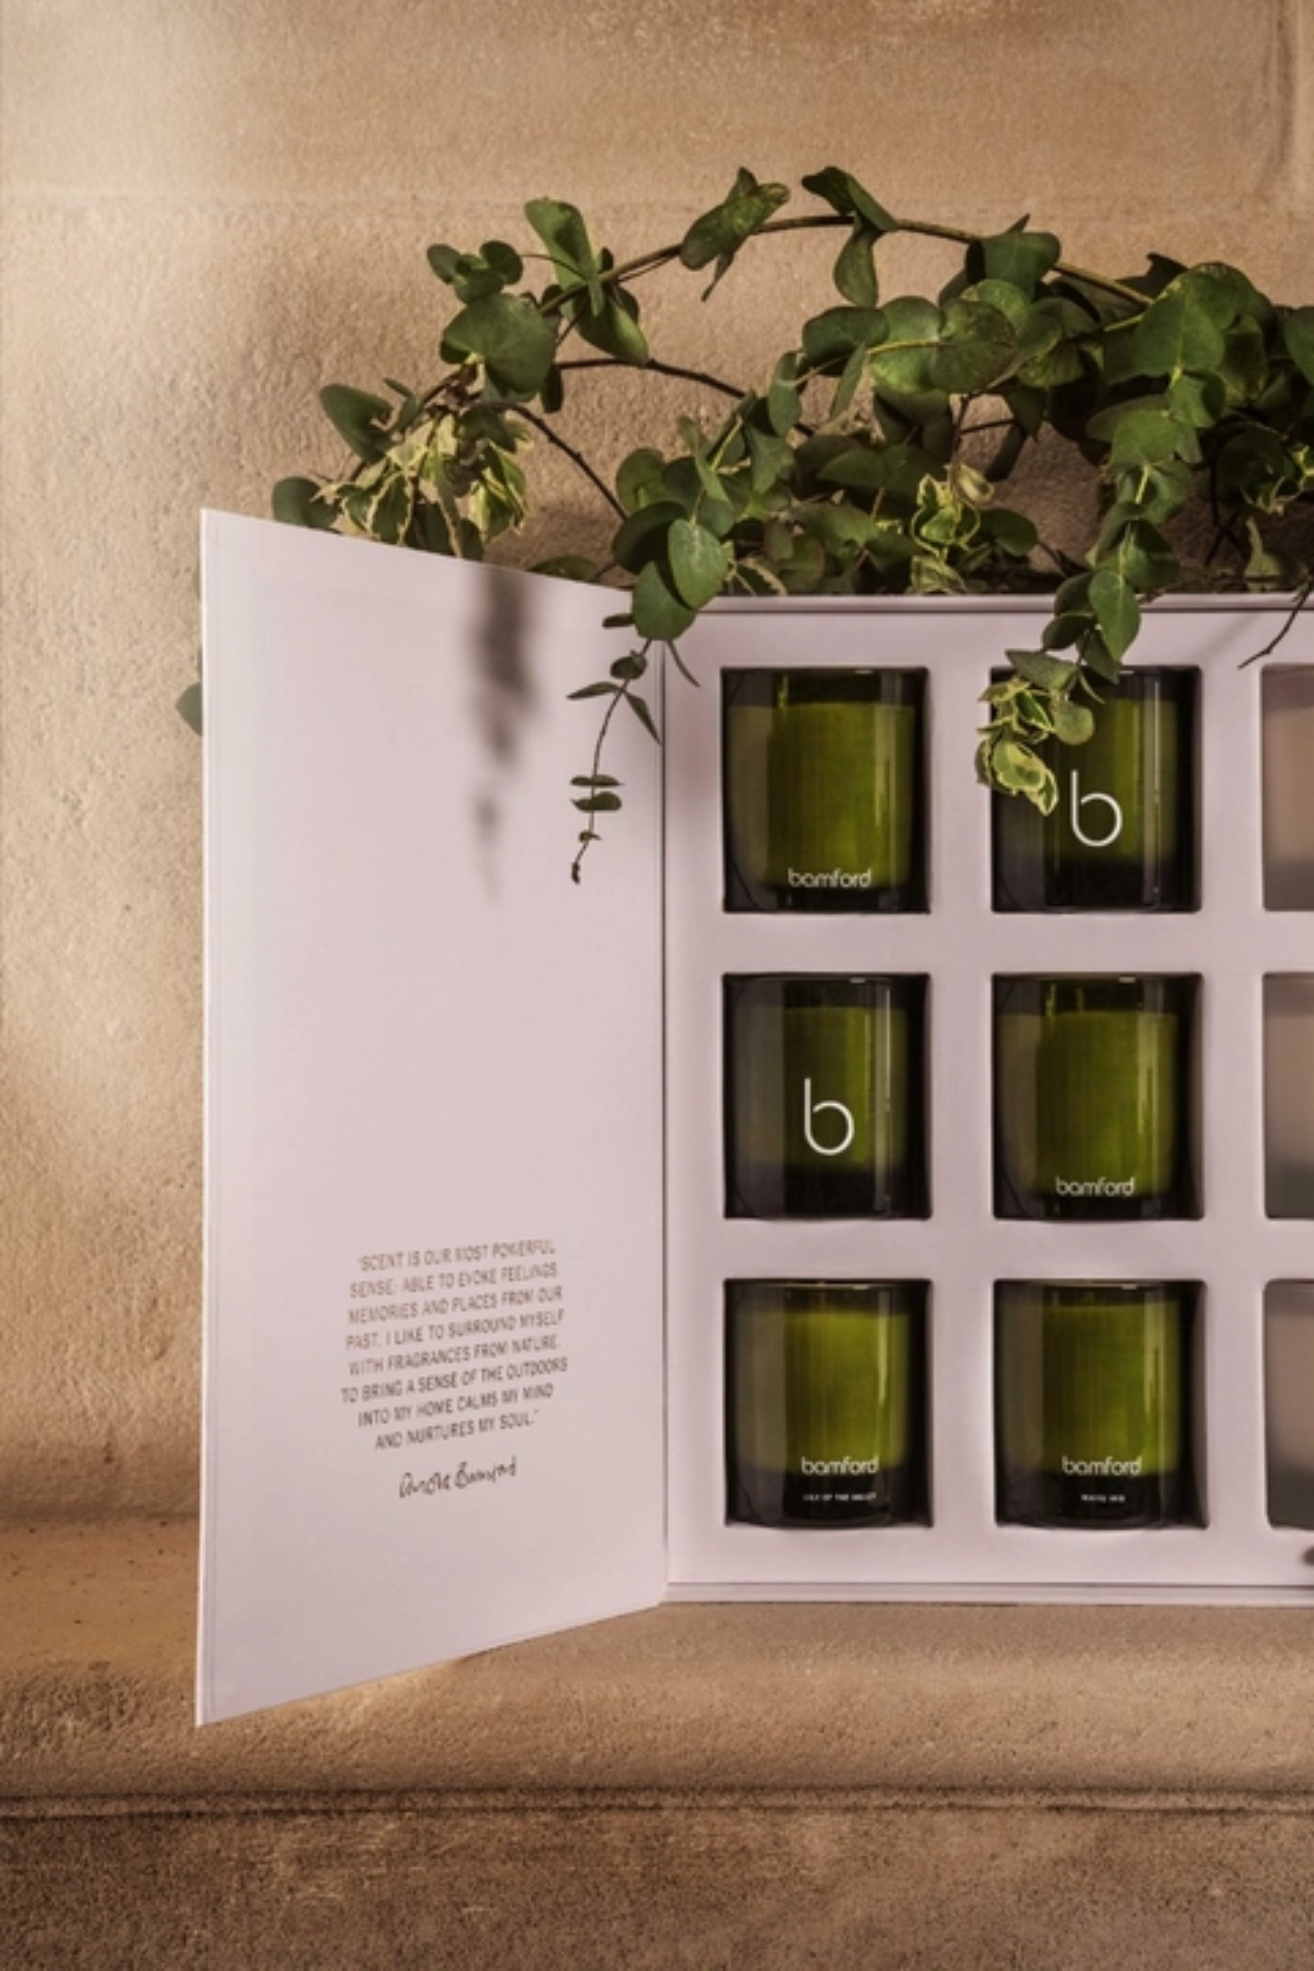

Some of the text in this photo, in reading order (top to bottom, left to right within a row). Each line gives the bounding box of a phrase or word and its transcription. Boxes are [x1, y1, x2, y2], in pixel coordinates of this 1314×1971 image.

[1070, 769, 1123, 847] b
[788, 868, 871, 888] bamford
[804, 1078, 855, 1156] b
[1056, 1177, 1134, 1197] bamford
[407, 1250, 420, 1268] IS
[424, 1248, 451, 1266] OUR
[454, 1244, 489, 1263] MOST
[492, 1239, 556, 1259] POWERFUL
[402, 1275, 434, 1293] ABLE
[439, 1273, 455, 1289] TO
[457, 1268, 496, 1286] EVOKE
[347, 1286, 563, 1325] MEMORIES AND PLACES FROM OUR
[394, 1326, 423, 1345] LIKE
[428, 1324, 444, 1340] TO
[448, 1315, 517, 1338] SURROUND
[519, 1308, 565, 1328] MYSELF
[348, 1358, 384, 1377] WITH
[387, 1345, 471, 1371] FRAGRANCES
[473, 1341, 508, 1360] FROM
[341, 1357, 568, 1404] TO BRING A SENSE OF THE OUTDOORS
[358, 1382, 554, 1427] INTO MY HOME CALMS MY MIND
[375, 1432, 403, 1450] AND
[406, 1419, 474, 1445] NURTURES
[478, 1417, 495, 1433] MY
[801, 1456, 879, 1476] bamford
[1062, 1456, 1142, 1476] bamford
